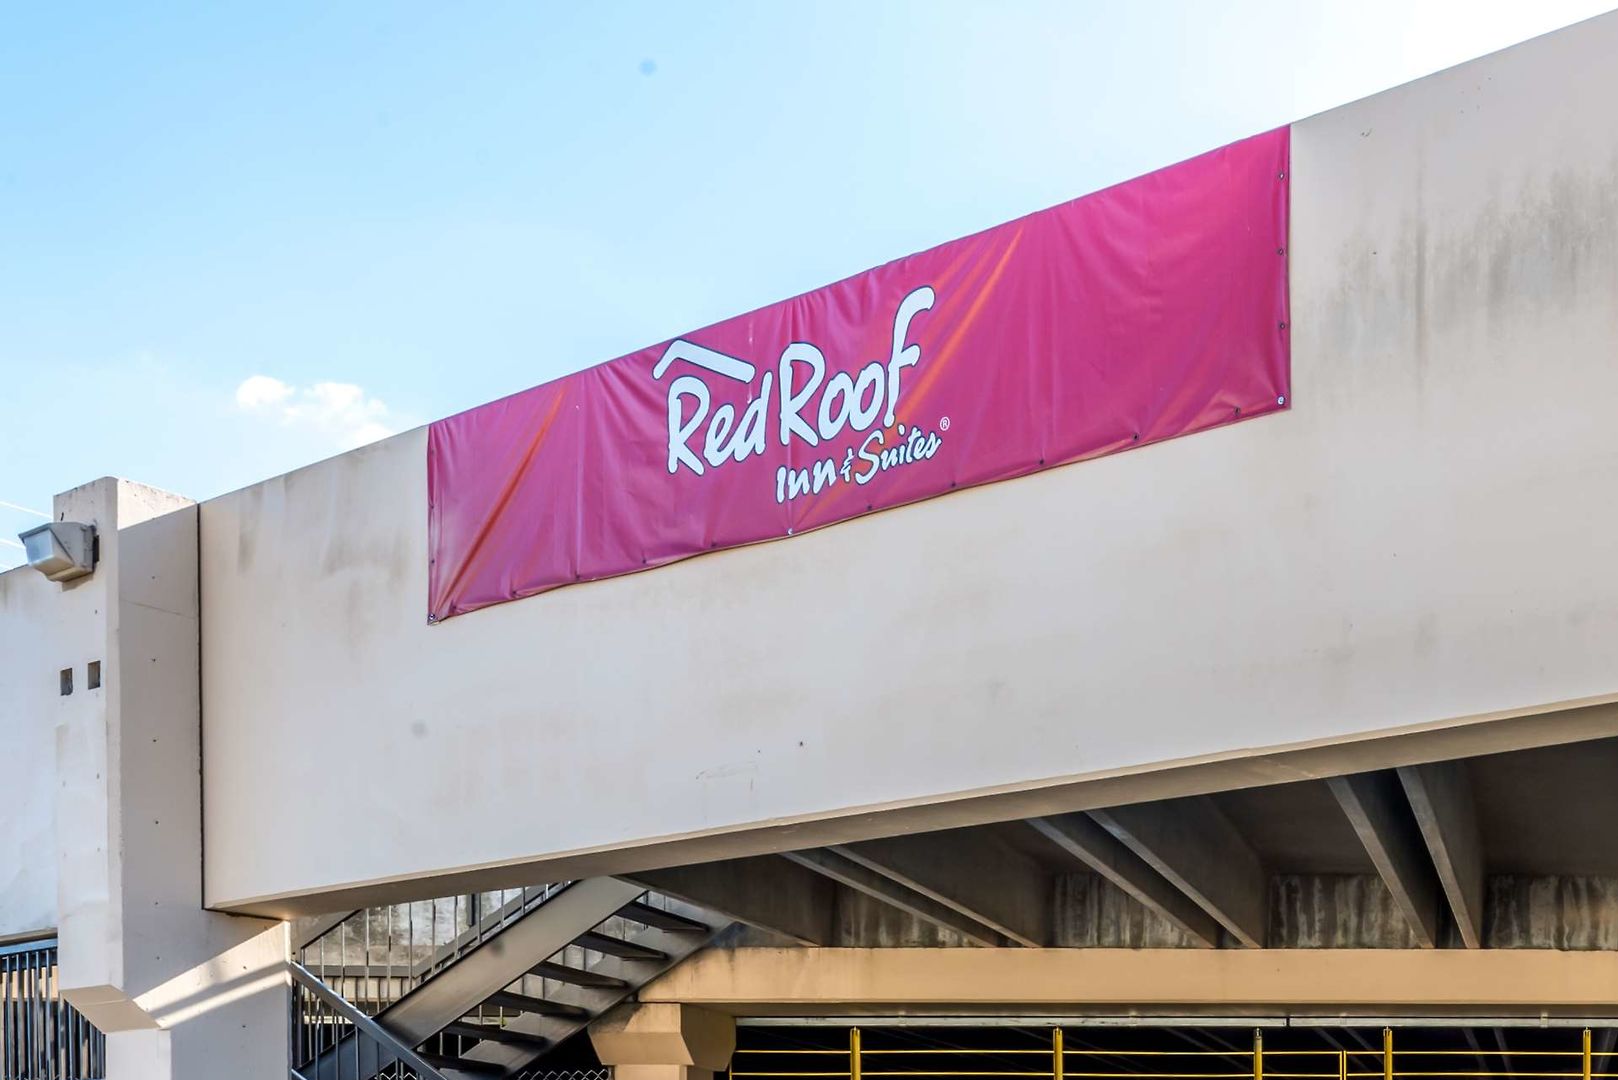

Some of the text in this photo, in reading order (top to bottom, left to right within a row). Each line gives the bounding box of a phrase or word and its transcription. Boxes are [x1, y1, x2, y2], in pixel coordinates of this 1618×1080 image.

[667, 285, 936, 476] Red Roof
[776, 457, 837, 503] Inn
[840, 448, 854, 482] &
